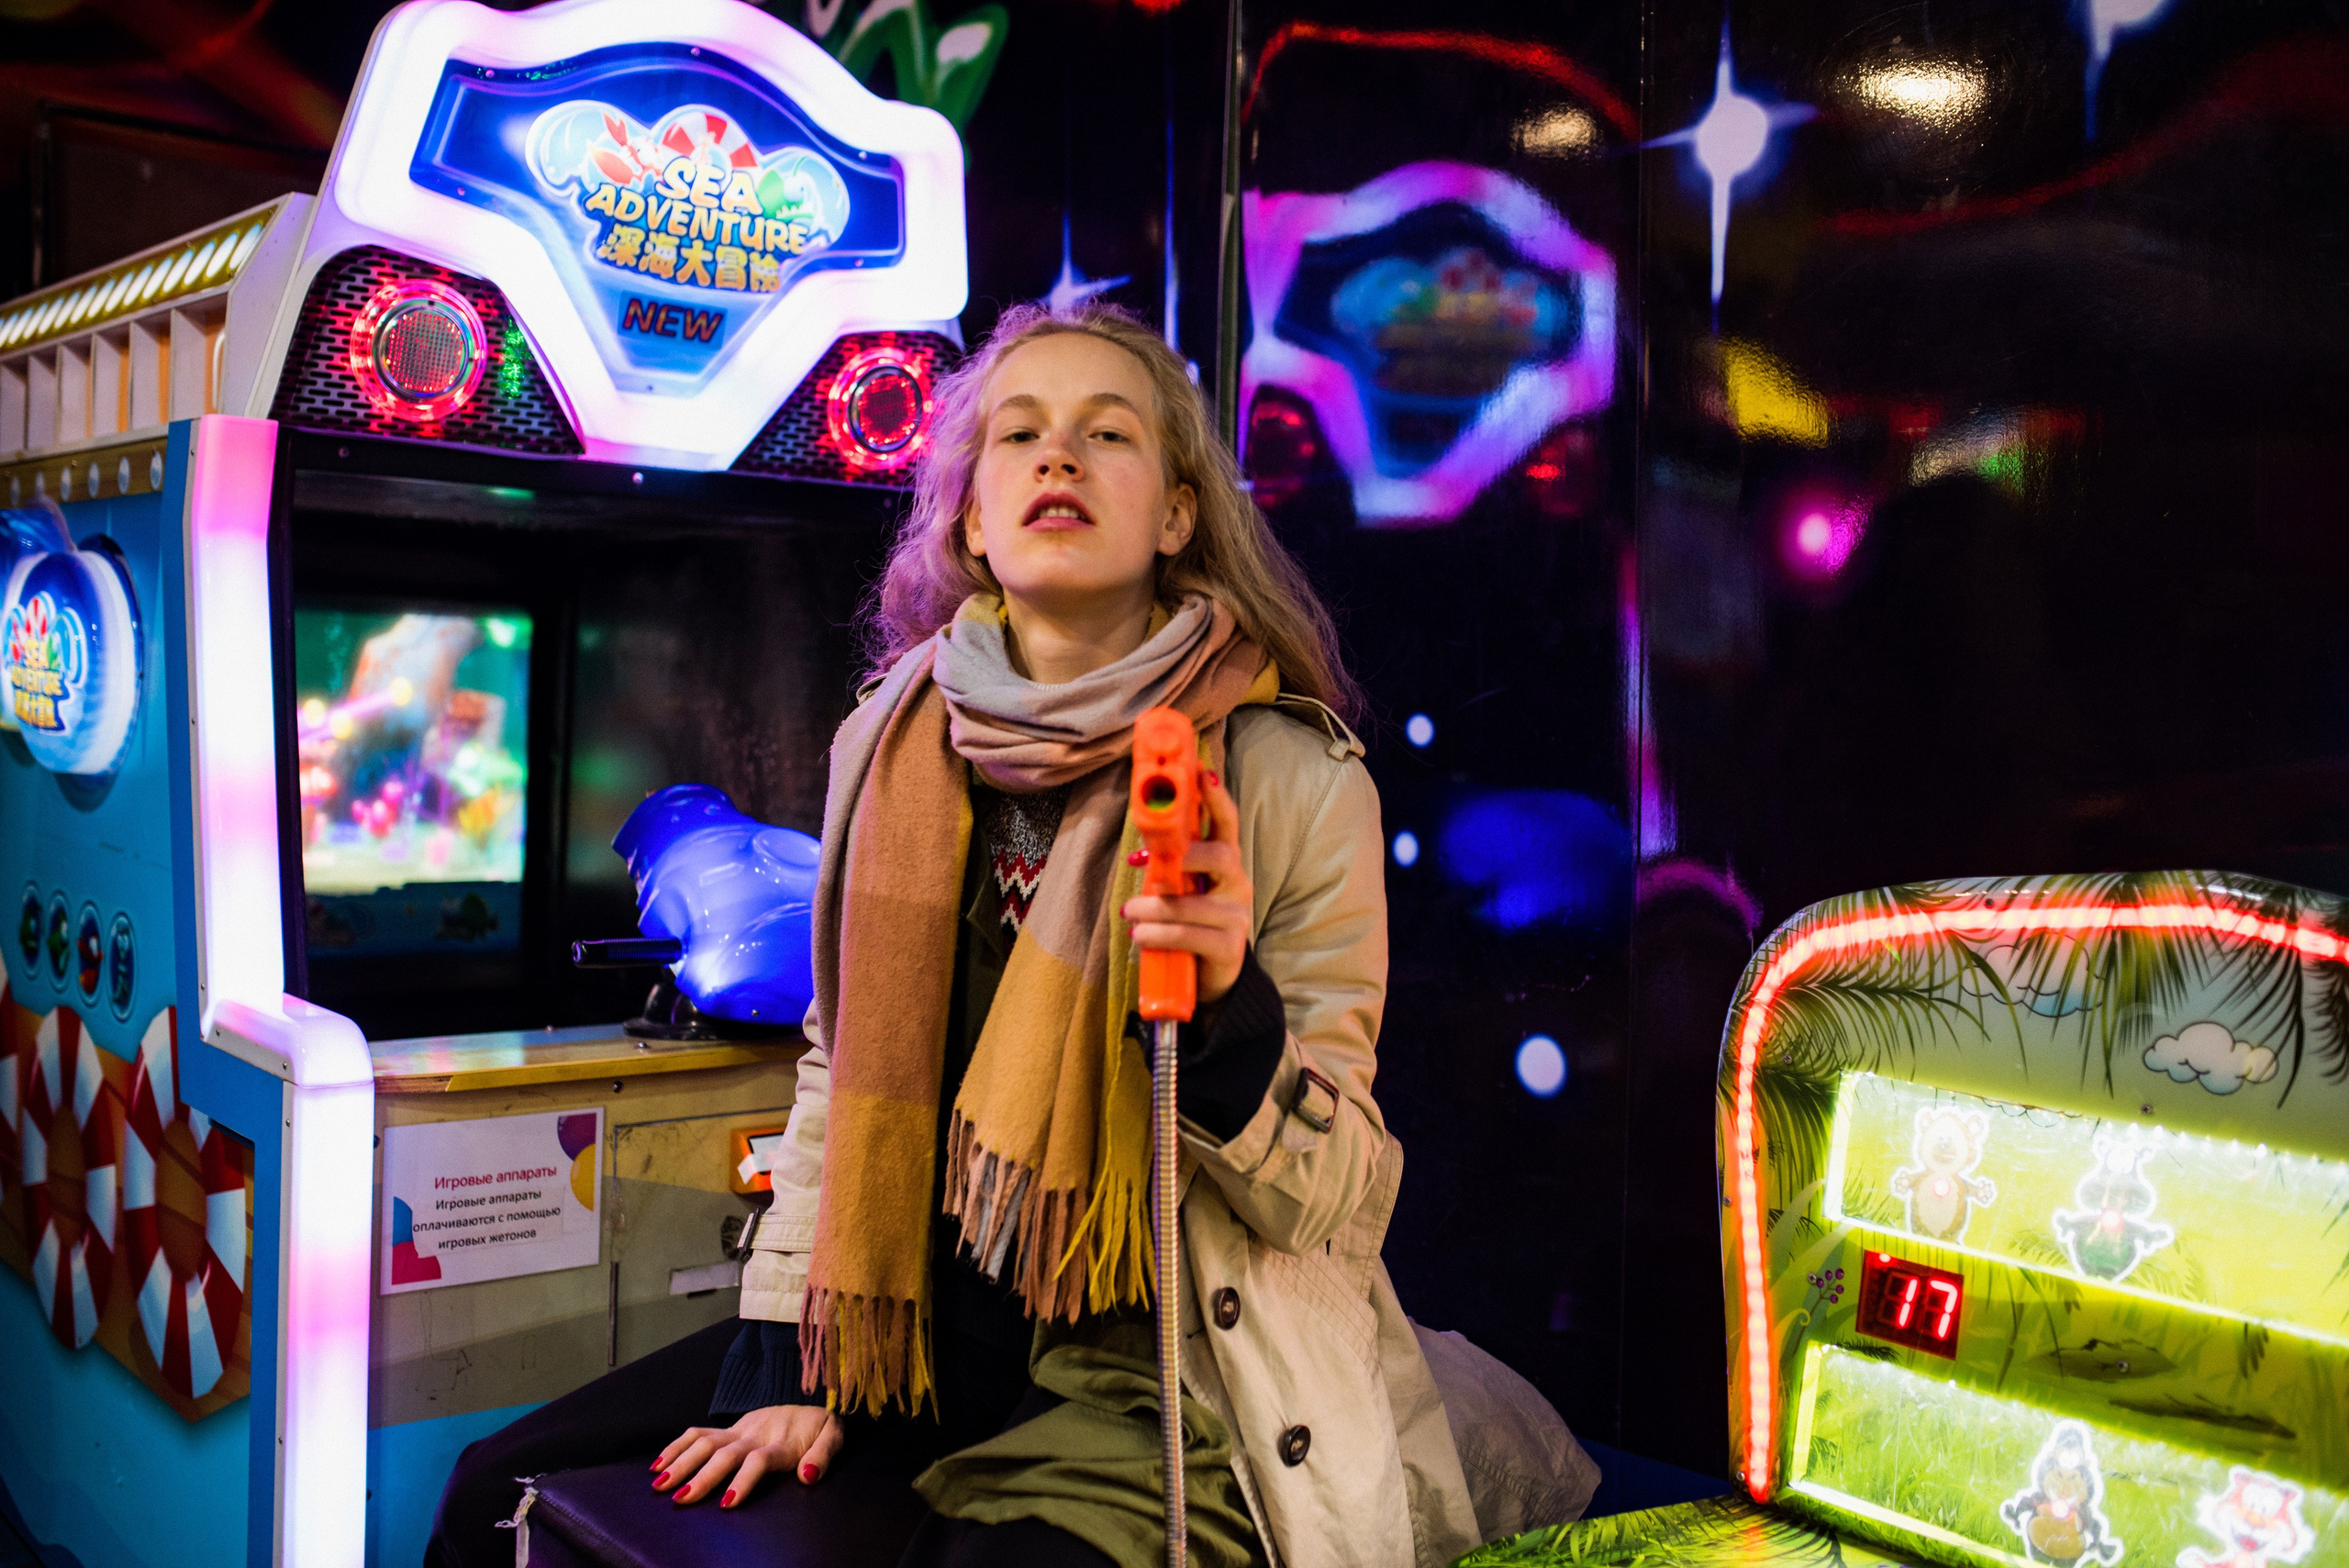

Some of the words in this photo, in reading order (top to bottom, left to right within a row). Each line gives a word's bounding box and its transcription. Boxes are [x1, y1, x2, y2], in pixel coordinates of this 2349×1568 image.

[656, 157, 763, 216] SEA
[585, 183, 809, 254] ADVENTURE
[622, 298, 723, 343] NEW
[434, 1173, 494, 1191] Игровые
[495, 1166, 558, 1182] аппараты
[436, 1196, 486, 1211] Игровые
[488, 1190, 542, 1204] аппараты
[412, 1216, 495, 1233] оплачиваются
[497, 1214, 505, 1223] с
[507, 1207, 562, 1222] помощью
[438, 1235, 487, 1251] игровых
[488, 1229, 538, 1243] жетонов
[1898, 1278, 1958, 1339] 17
